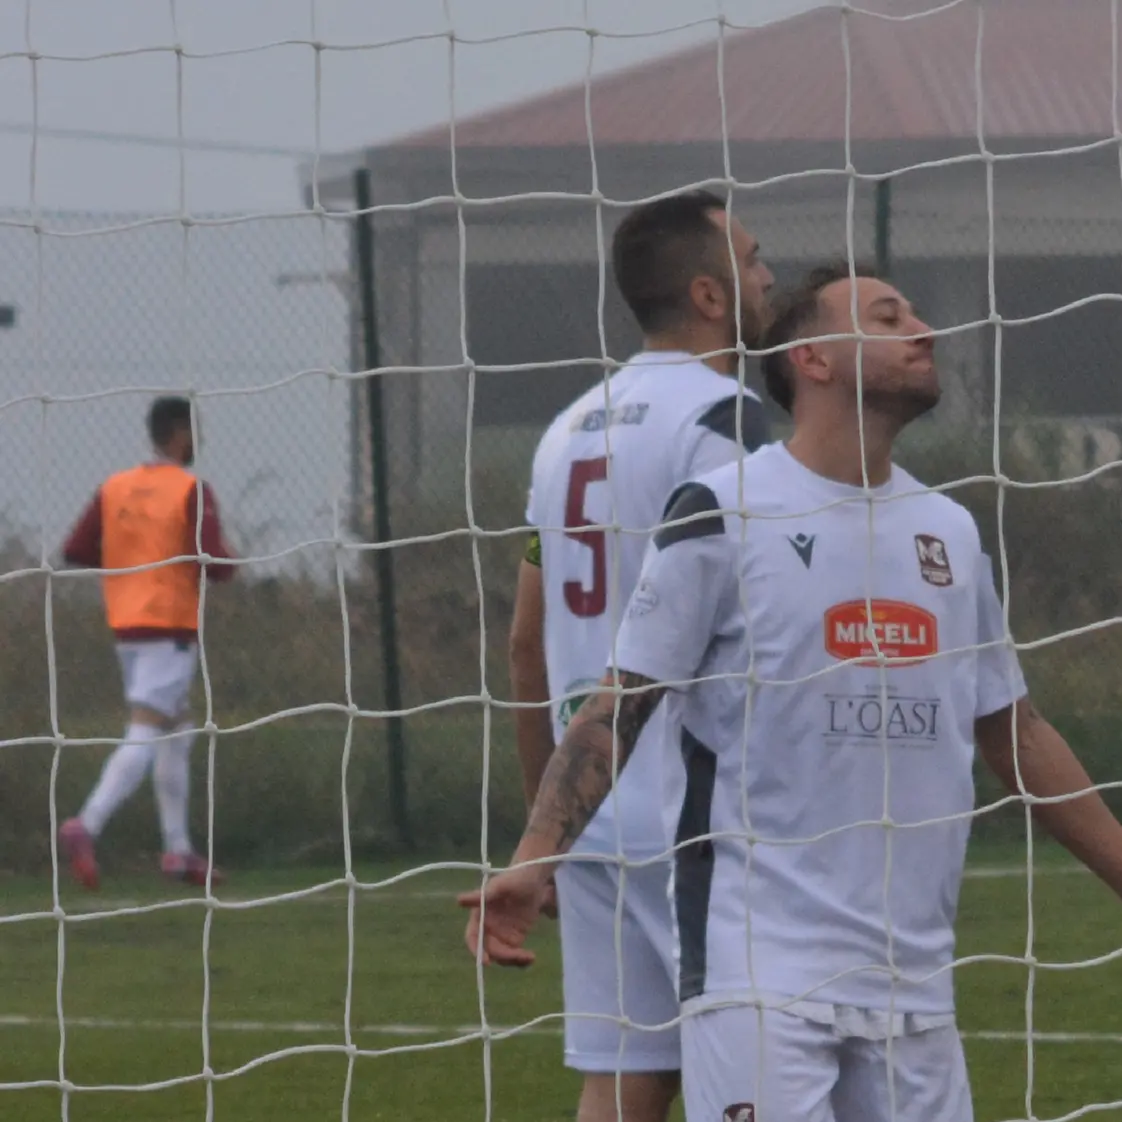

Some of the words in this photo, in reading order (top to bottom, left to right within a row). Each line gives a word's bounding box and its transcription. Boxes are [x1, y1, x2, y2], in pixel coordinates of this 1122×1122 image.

[563, 455, 612, 619] 5
[835, 621, 926, 646] MICELI
[828, 700, 941, 736] L'OASI
